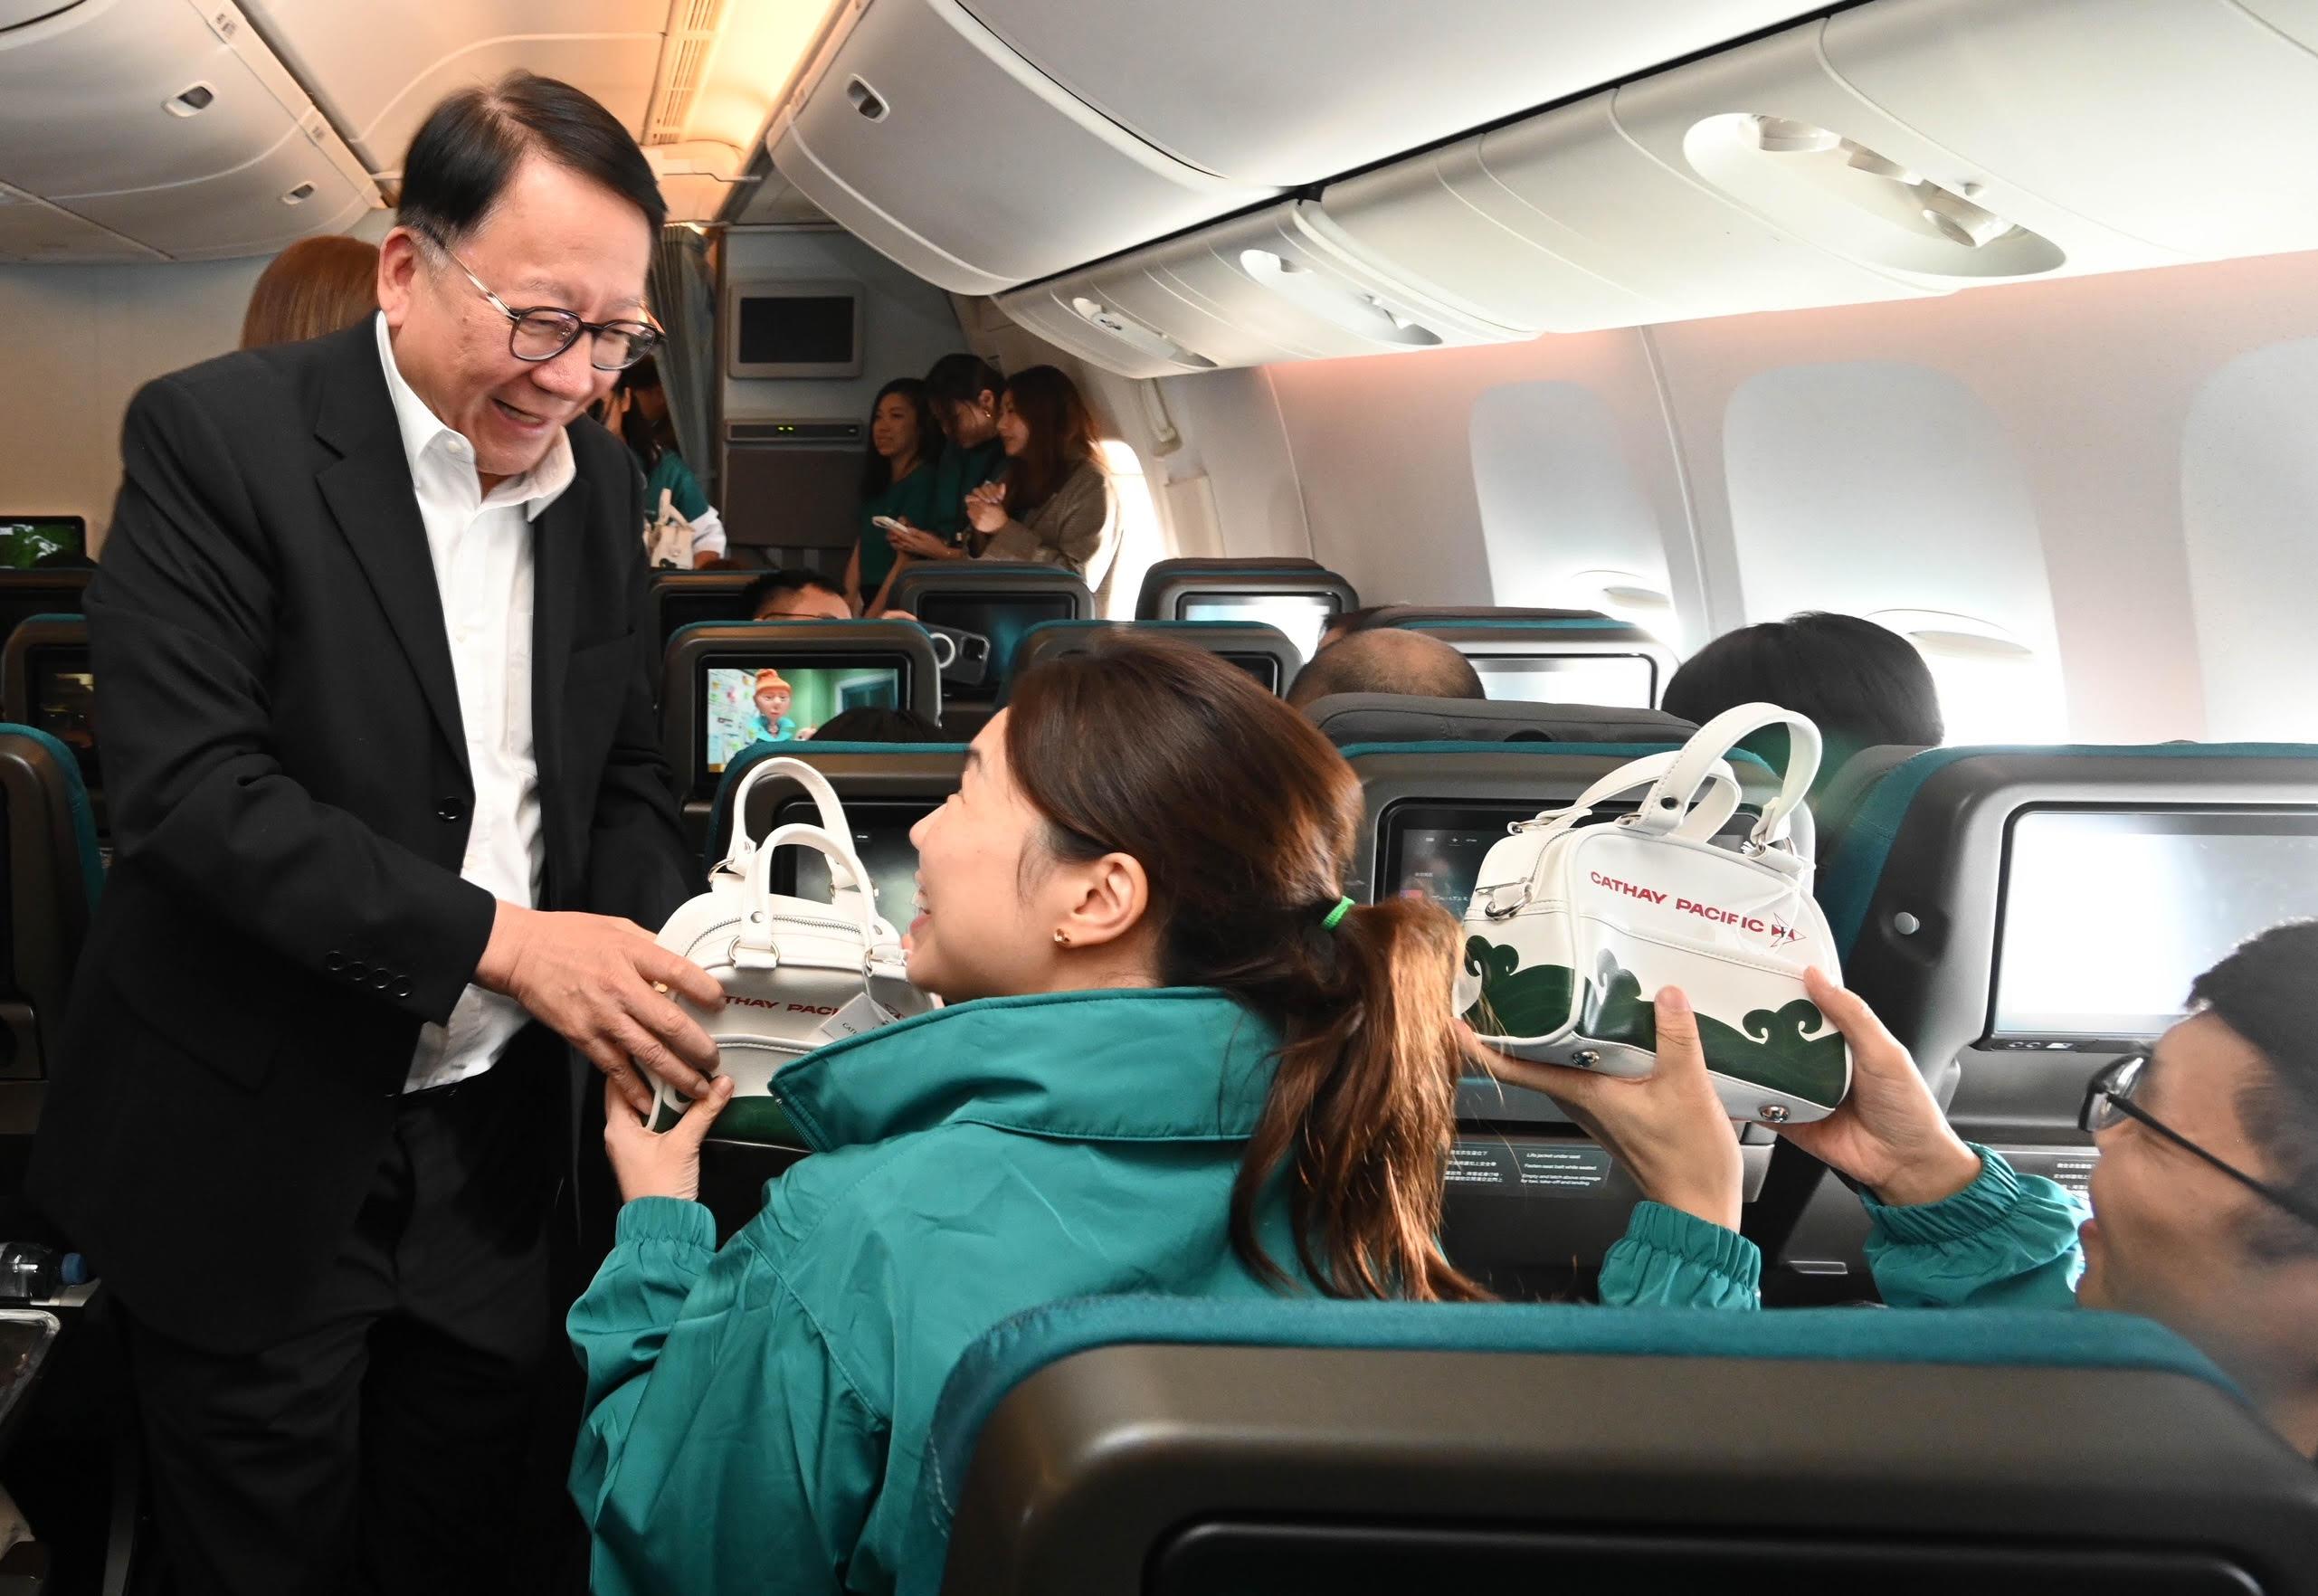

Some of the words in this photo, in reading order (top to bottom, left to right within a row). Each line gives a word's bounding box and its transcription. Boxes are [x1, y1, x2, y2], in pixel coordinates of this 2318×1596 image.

[1590, 870, 1668, 906] CATHAY
[1675, 898, 1764, 933] PACIFIC
[724, 995, 781, 1009] THAY
[786, 1003, 840, 1016] PACI
